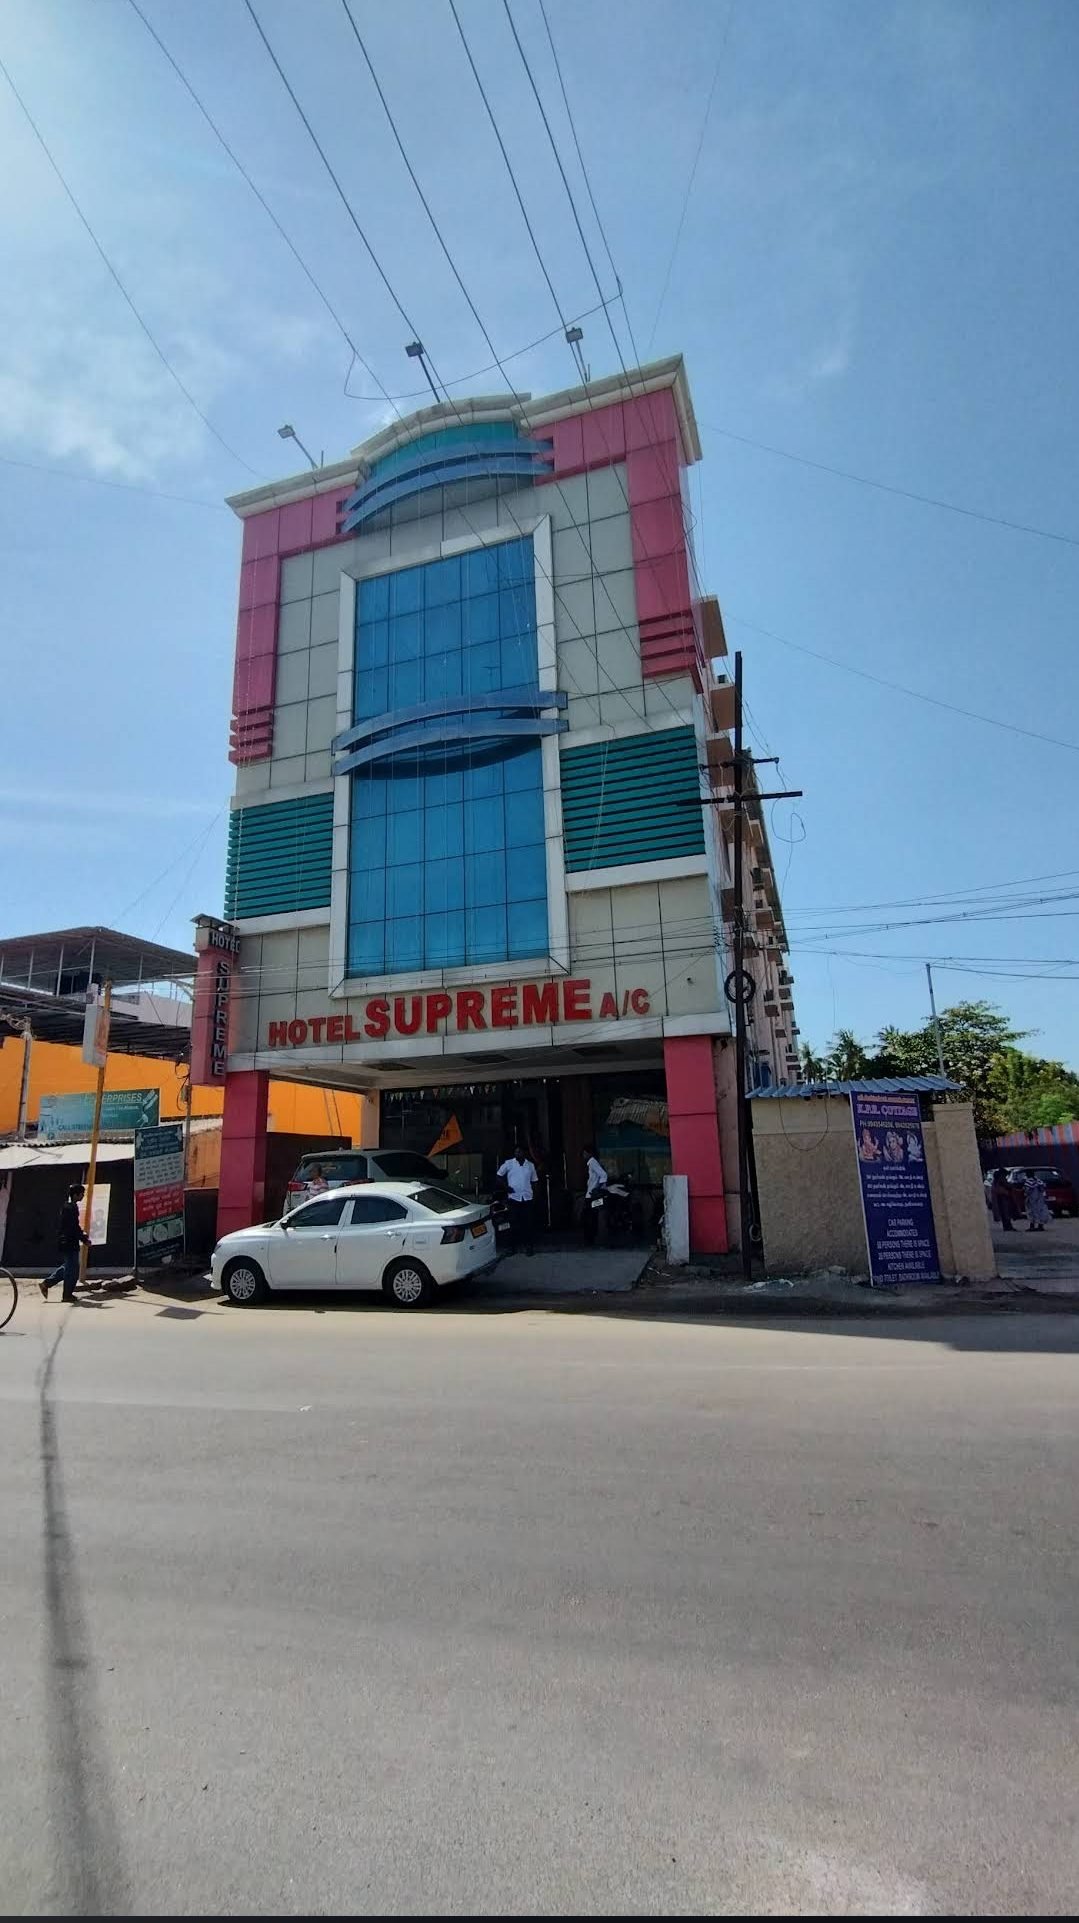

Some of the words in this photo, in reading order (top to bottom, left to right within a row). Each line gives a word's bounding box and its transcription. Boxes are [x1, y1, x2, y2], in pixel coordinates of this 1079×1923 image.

[211, 932, 241, 953] HOTEL
[214, 961, 230, 1076] SUPREME
[268, 1015, 361, 1047] HOTEL
[364, 978, 593, 1039] SUPREME
[599, 987, 651, 1019] A/C
